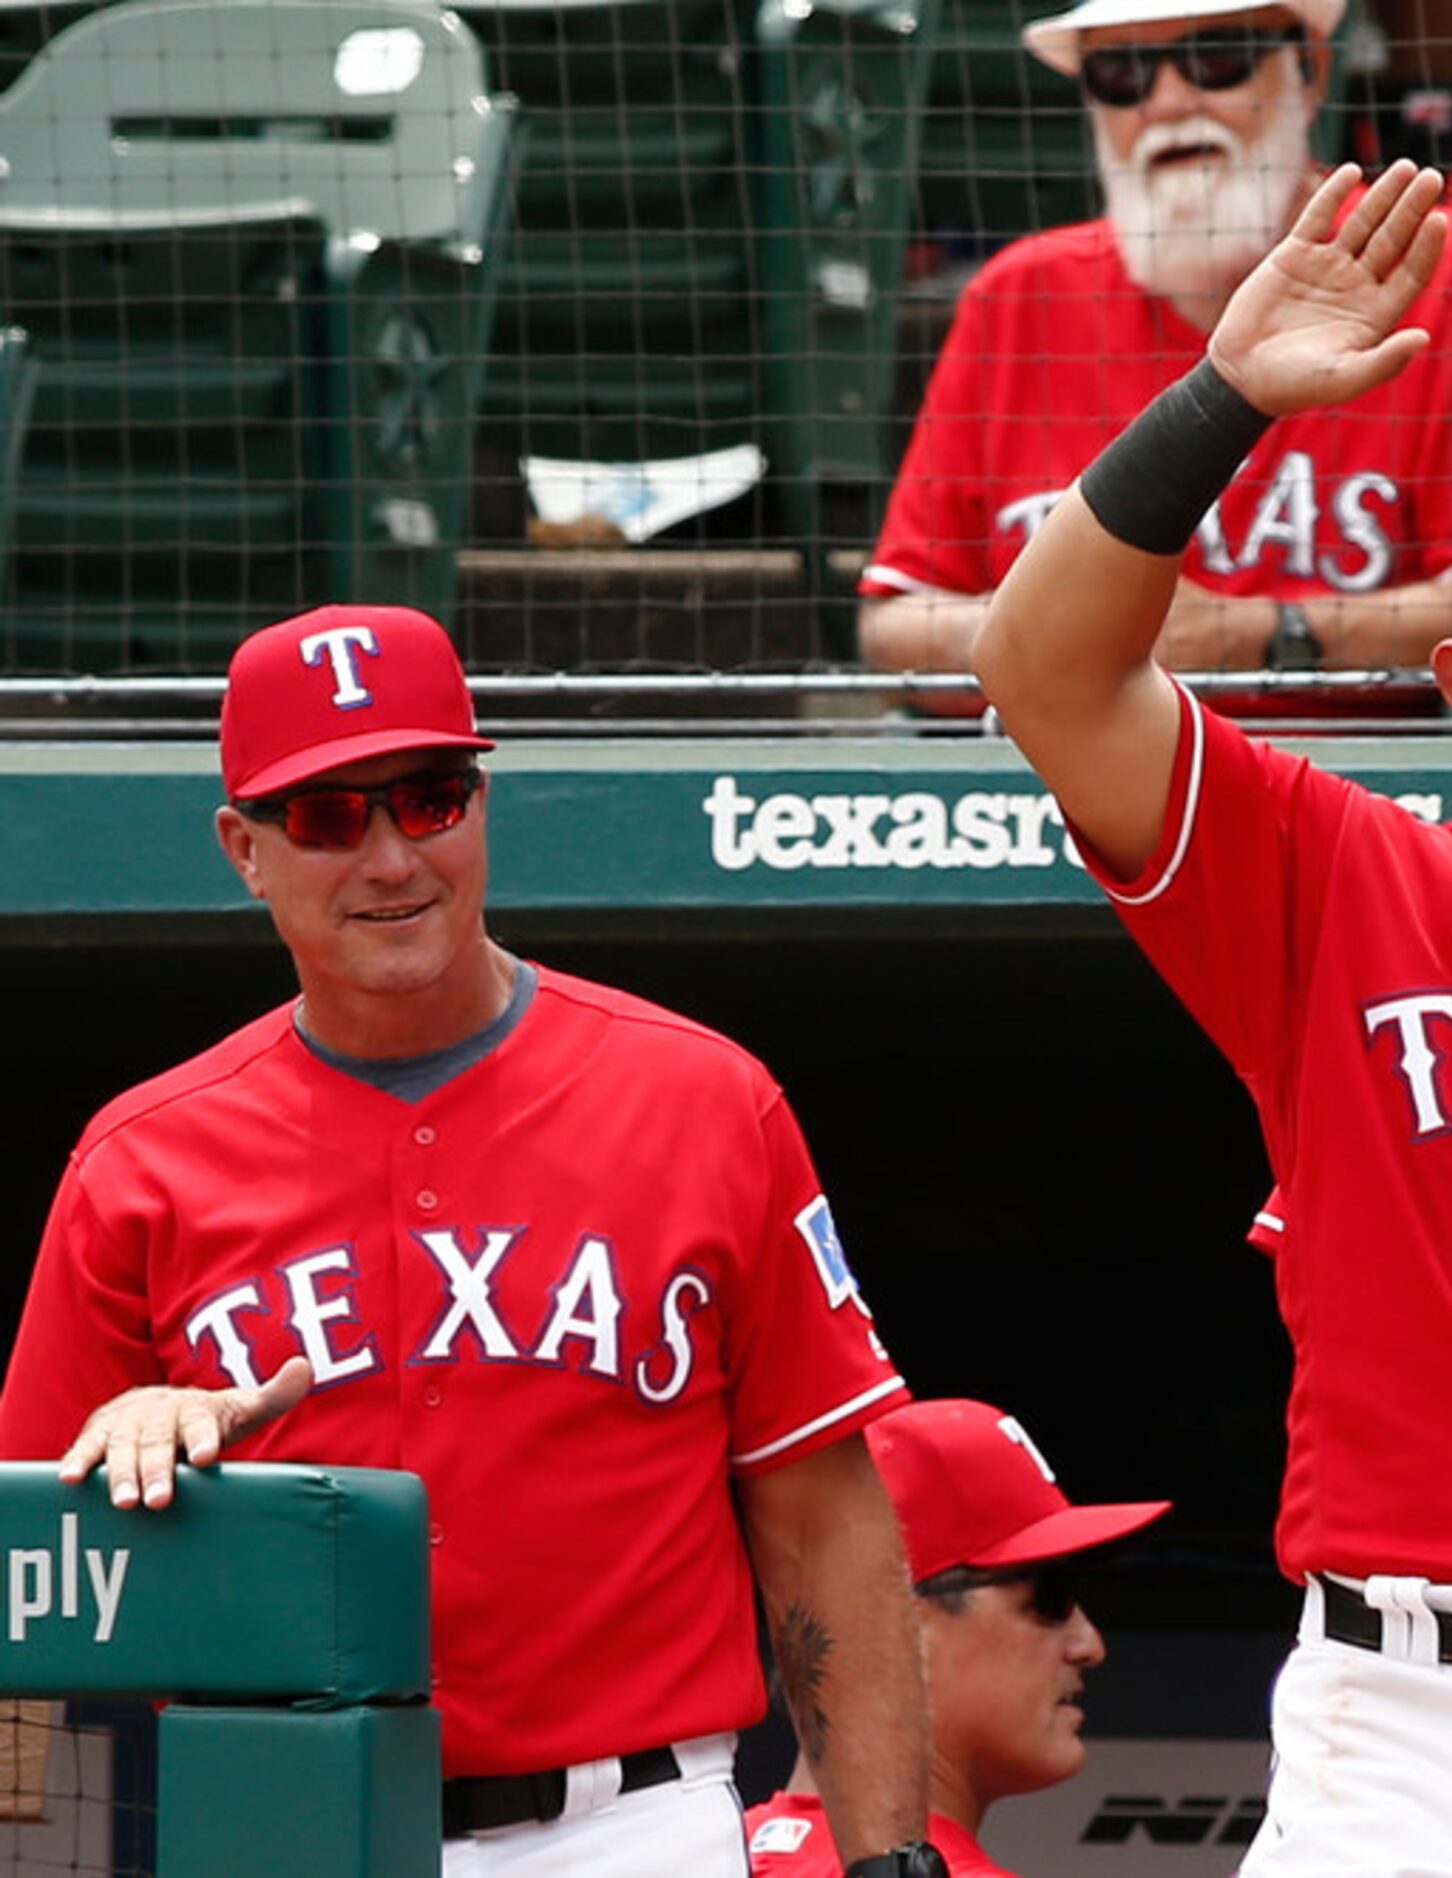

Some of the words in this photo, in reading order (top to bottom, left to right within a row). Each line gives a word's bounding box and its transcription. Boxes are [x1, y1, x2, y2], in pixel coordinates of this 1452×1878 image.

[996, 450, 1399, 592] TAS
[299, 626, 382, 711] T
[703, 776, 1088, 869] texasr
[183, 1224, 712, 1408] TEXAS
[9, 1512, 130, 1642] ply
